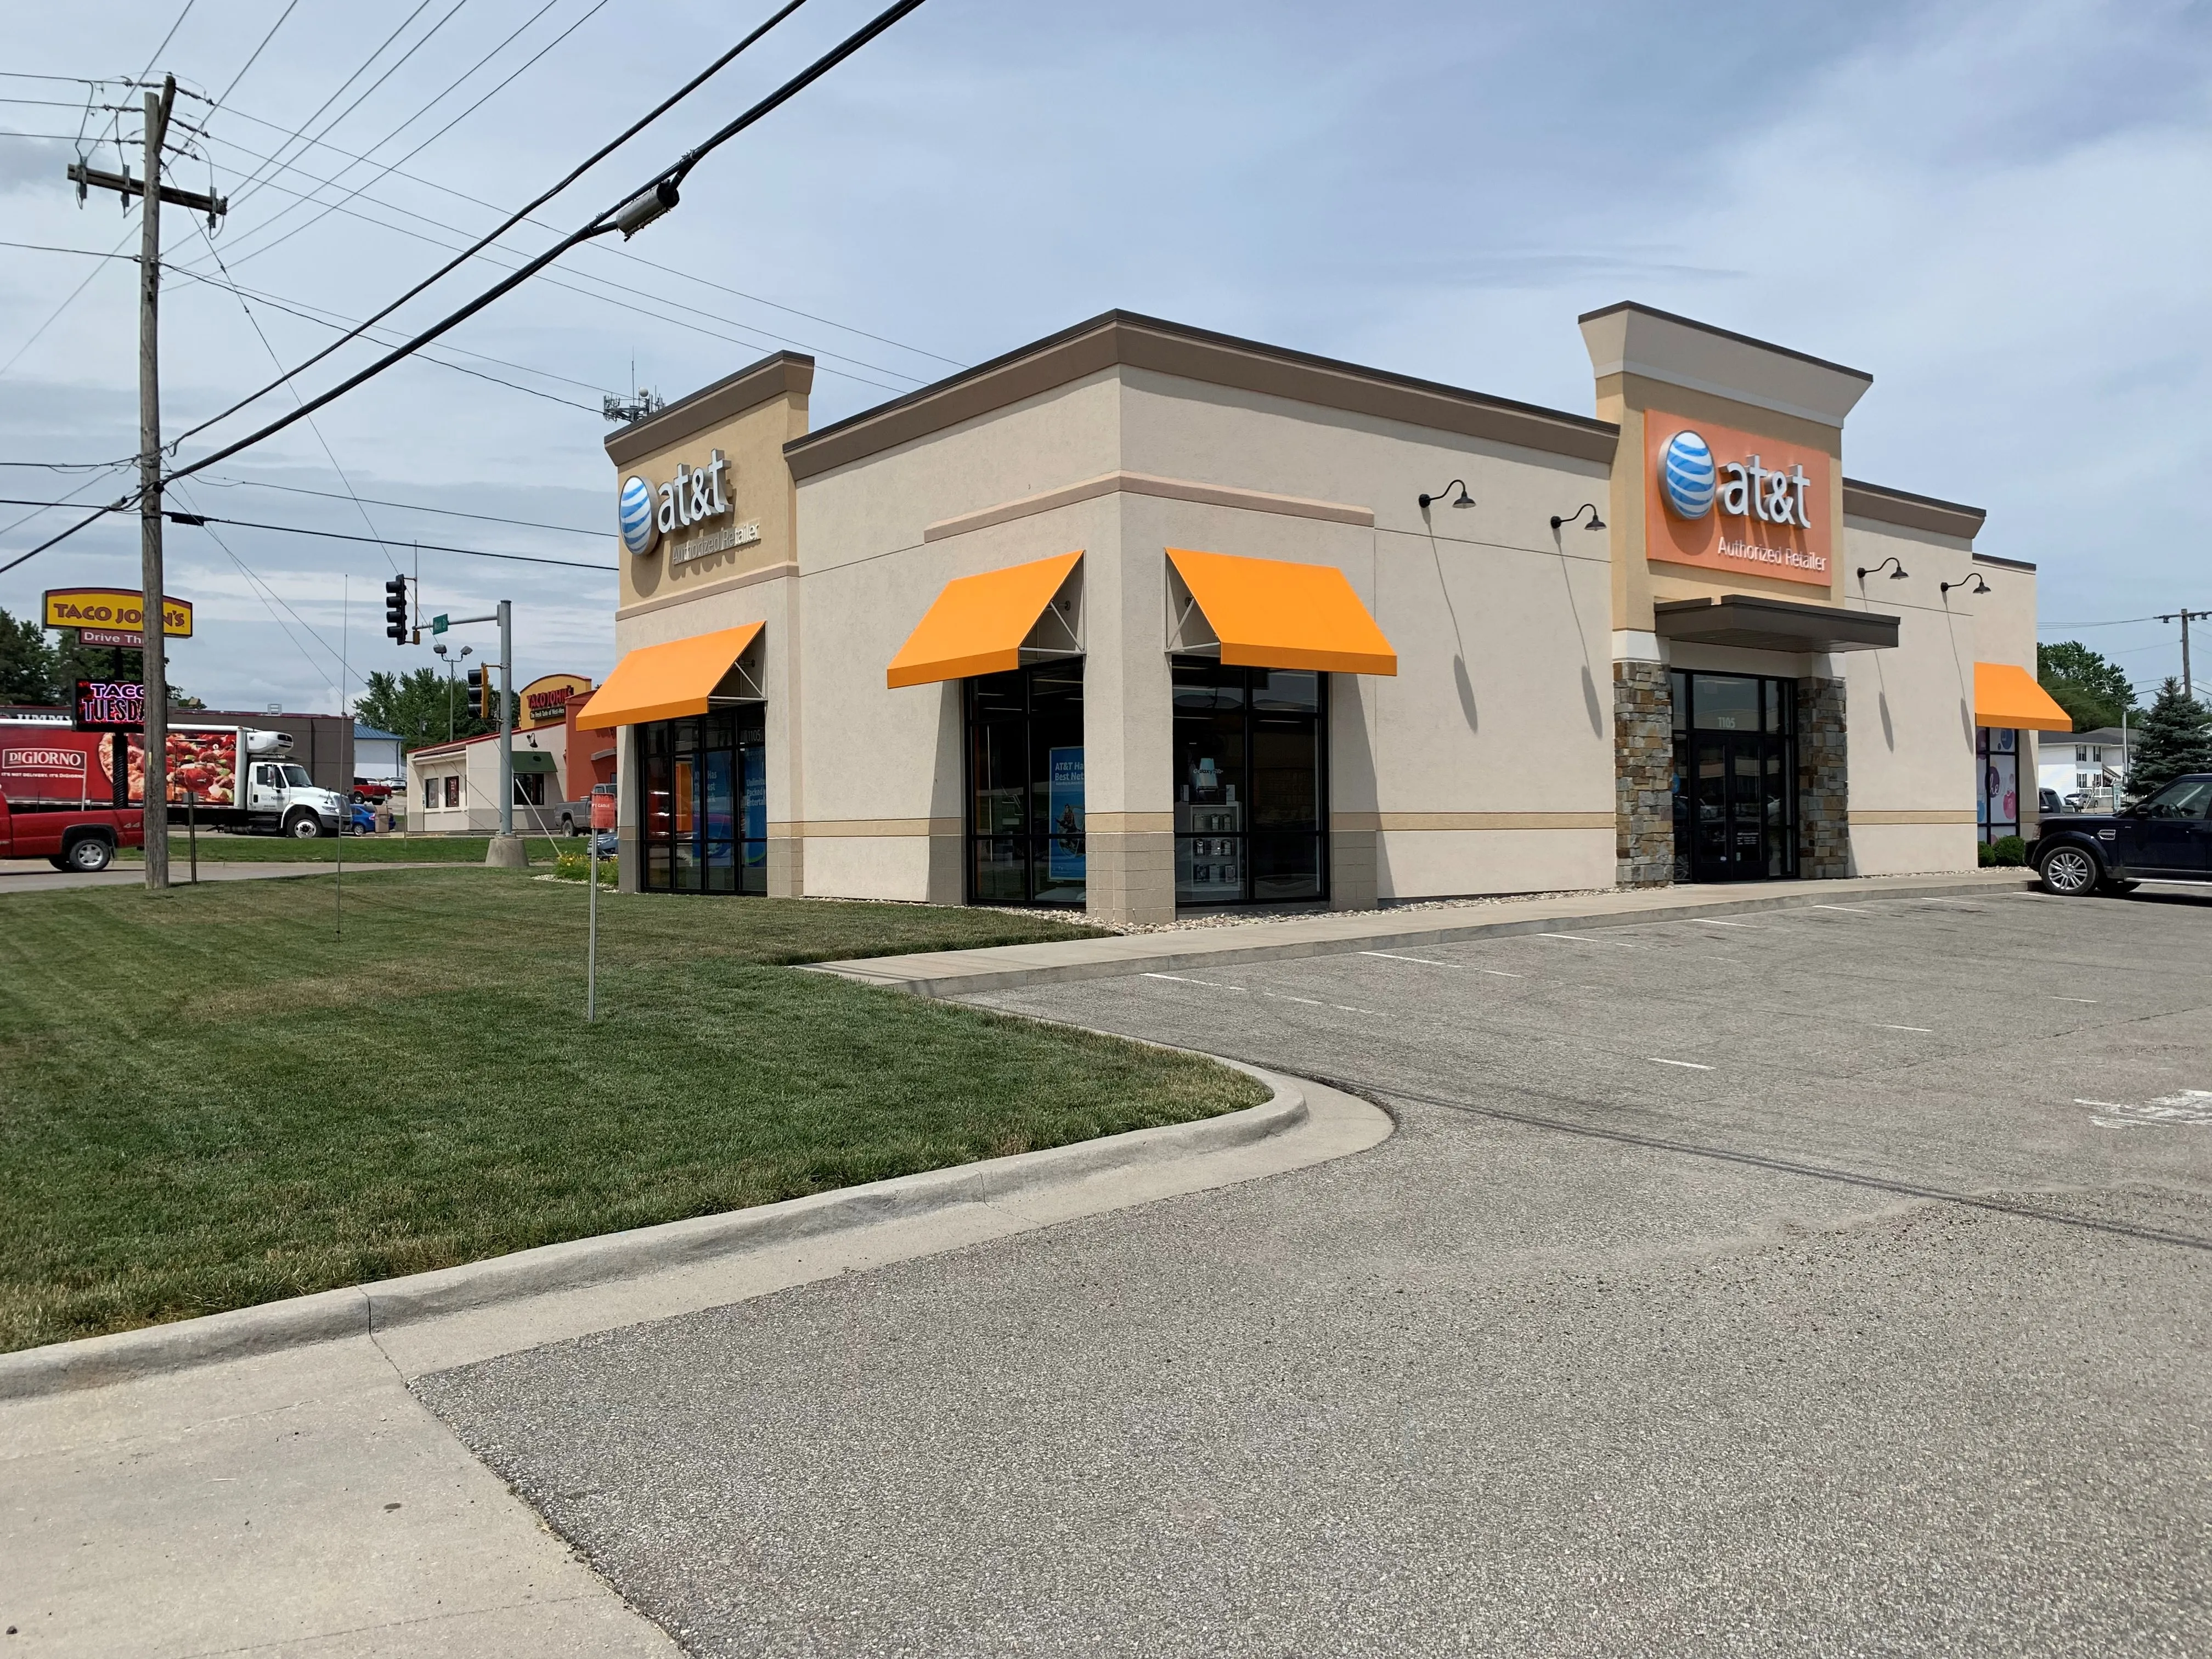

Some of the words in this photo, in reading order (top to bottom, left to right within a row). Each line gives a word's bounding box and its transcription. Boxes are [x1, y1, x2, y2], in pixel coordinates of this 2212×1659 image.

[658, 448, 731, 533] at&t
[1718, 454, 1811, 529] at&t
[672, 531, 721, 565] Authorized
[722, 523, 760, 548] Retailer
[1718, 536, 1782, 564] Authorized
[1786, 548, 1826, 571] Retailer
[53, 603, 112, 621] TACO
[115, 608, 185, 627] JON'S
[84, 632, 120, 642] Drive
[527, 693, 546, 709] TACO
[82, 698, 144, 722] TUESDA
[1717, 716, 1736, 729] 1105
[748, 730, 761, 741] 1105
[1055, 761, 1073, 771] AT&T
[707, 770, 717, 780] Has
[1055, 772, 1070, 781] Best
[746, 788, 763, 797] Packed
